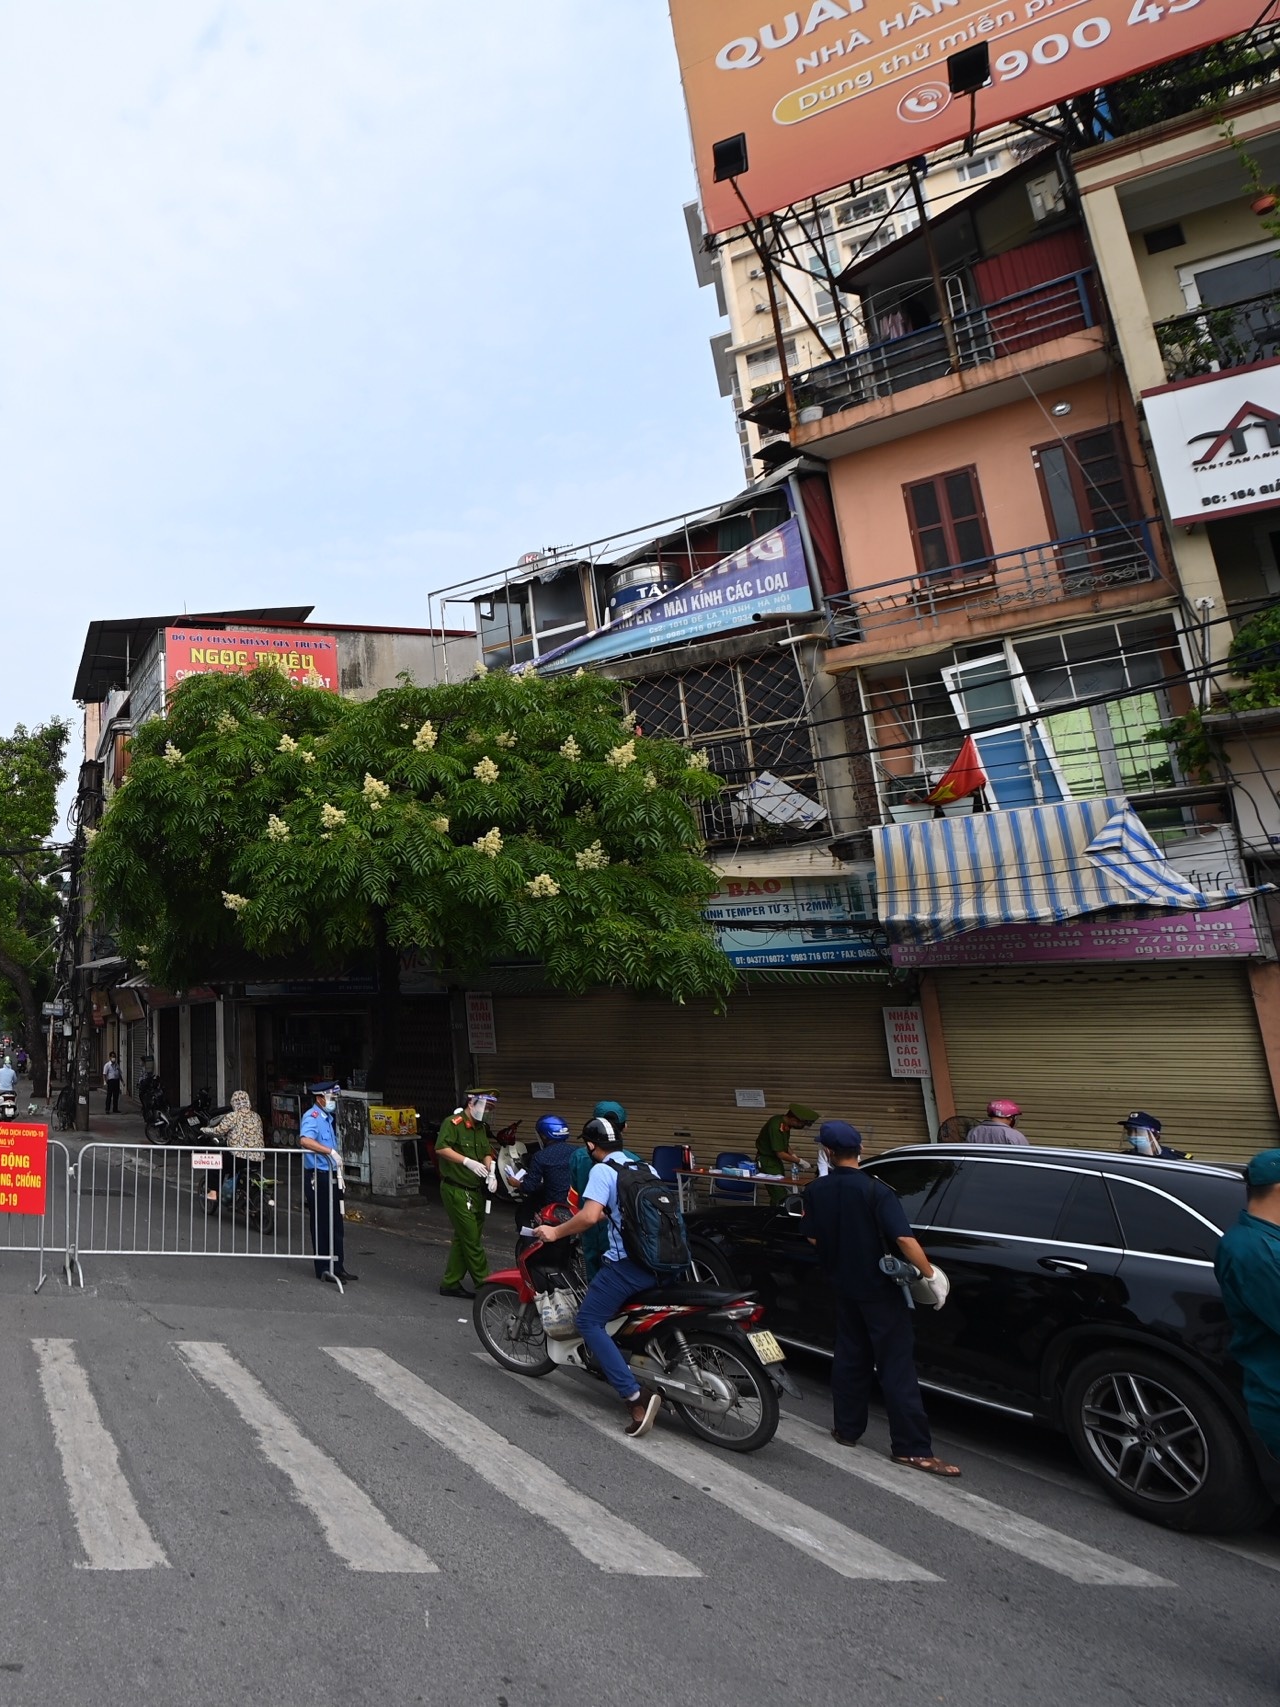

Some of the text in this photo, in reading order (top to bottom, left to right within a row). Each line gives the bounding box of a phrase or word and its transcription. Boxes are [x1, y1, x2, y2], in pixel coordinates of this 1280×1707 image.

[795, 28, 872, 74] NHÀ
[798, 7, 1015, 112] Dùng thử miễn
[982, 17, 1112, 87] 900
[636, 583, 669, 599] TÂ
[663, 571, 790, 618] MÀI KÍNH CÁC LOẠI
[190, 647, 315, 672] NGỌC TRIỆU
[726, 906, 765, 920] TEMPER
[783, 904, 790, 913] 3
[800, 899, 833, 913] 12MM
[893, 1033, 920, 1043] KÍNH
[896, 1045, 918, 1055] CÁC
[897, 1058, 922, 1069] LOẠI
[9, 1129, 22, 1137] DỊCH
[22, 1129, 44, 1138] COVID-19
[0, 1152, 30, 1170] ĐỘNG
[15, 1170, 42, 1188] CHỐNG
